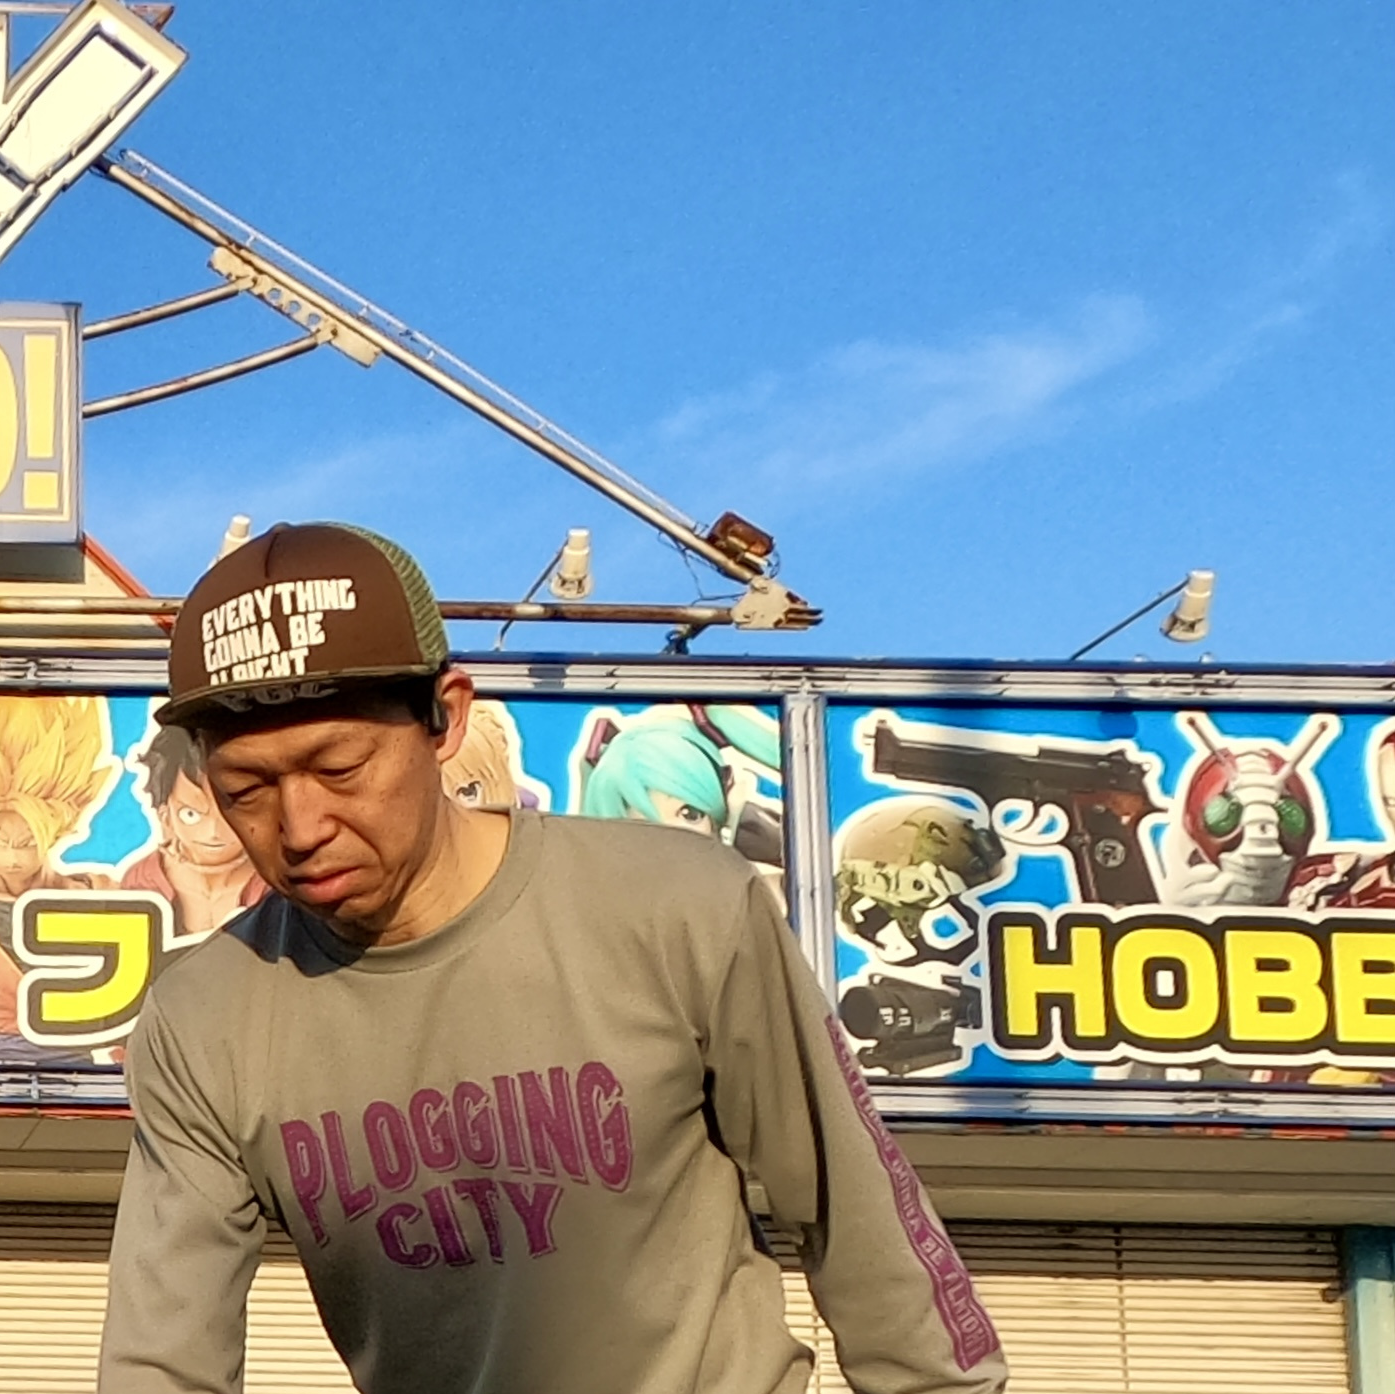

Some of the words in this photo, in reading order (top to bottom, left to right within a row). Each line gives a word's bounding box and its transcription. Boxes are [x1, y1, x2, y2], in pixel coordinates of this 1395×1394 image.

[201, 578, 357, 643] EVERYTHING
[203, 620, 281, 673] GONNA
[288, 611, 326, 649] BE
[280, 1061, 633, 1247] PLOGGING
[376, 1177, 564, 1269] CITY
